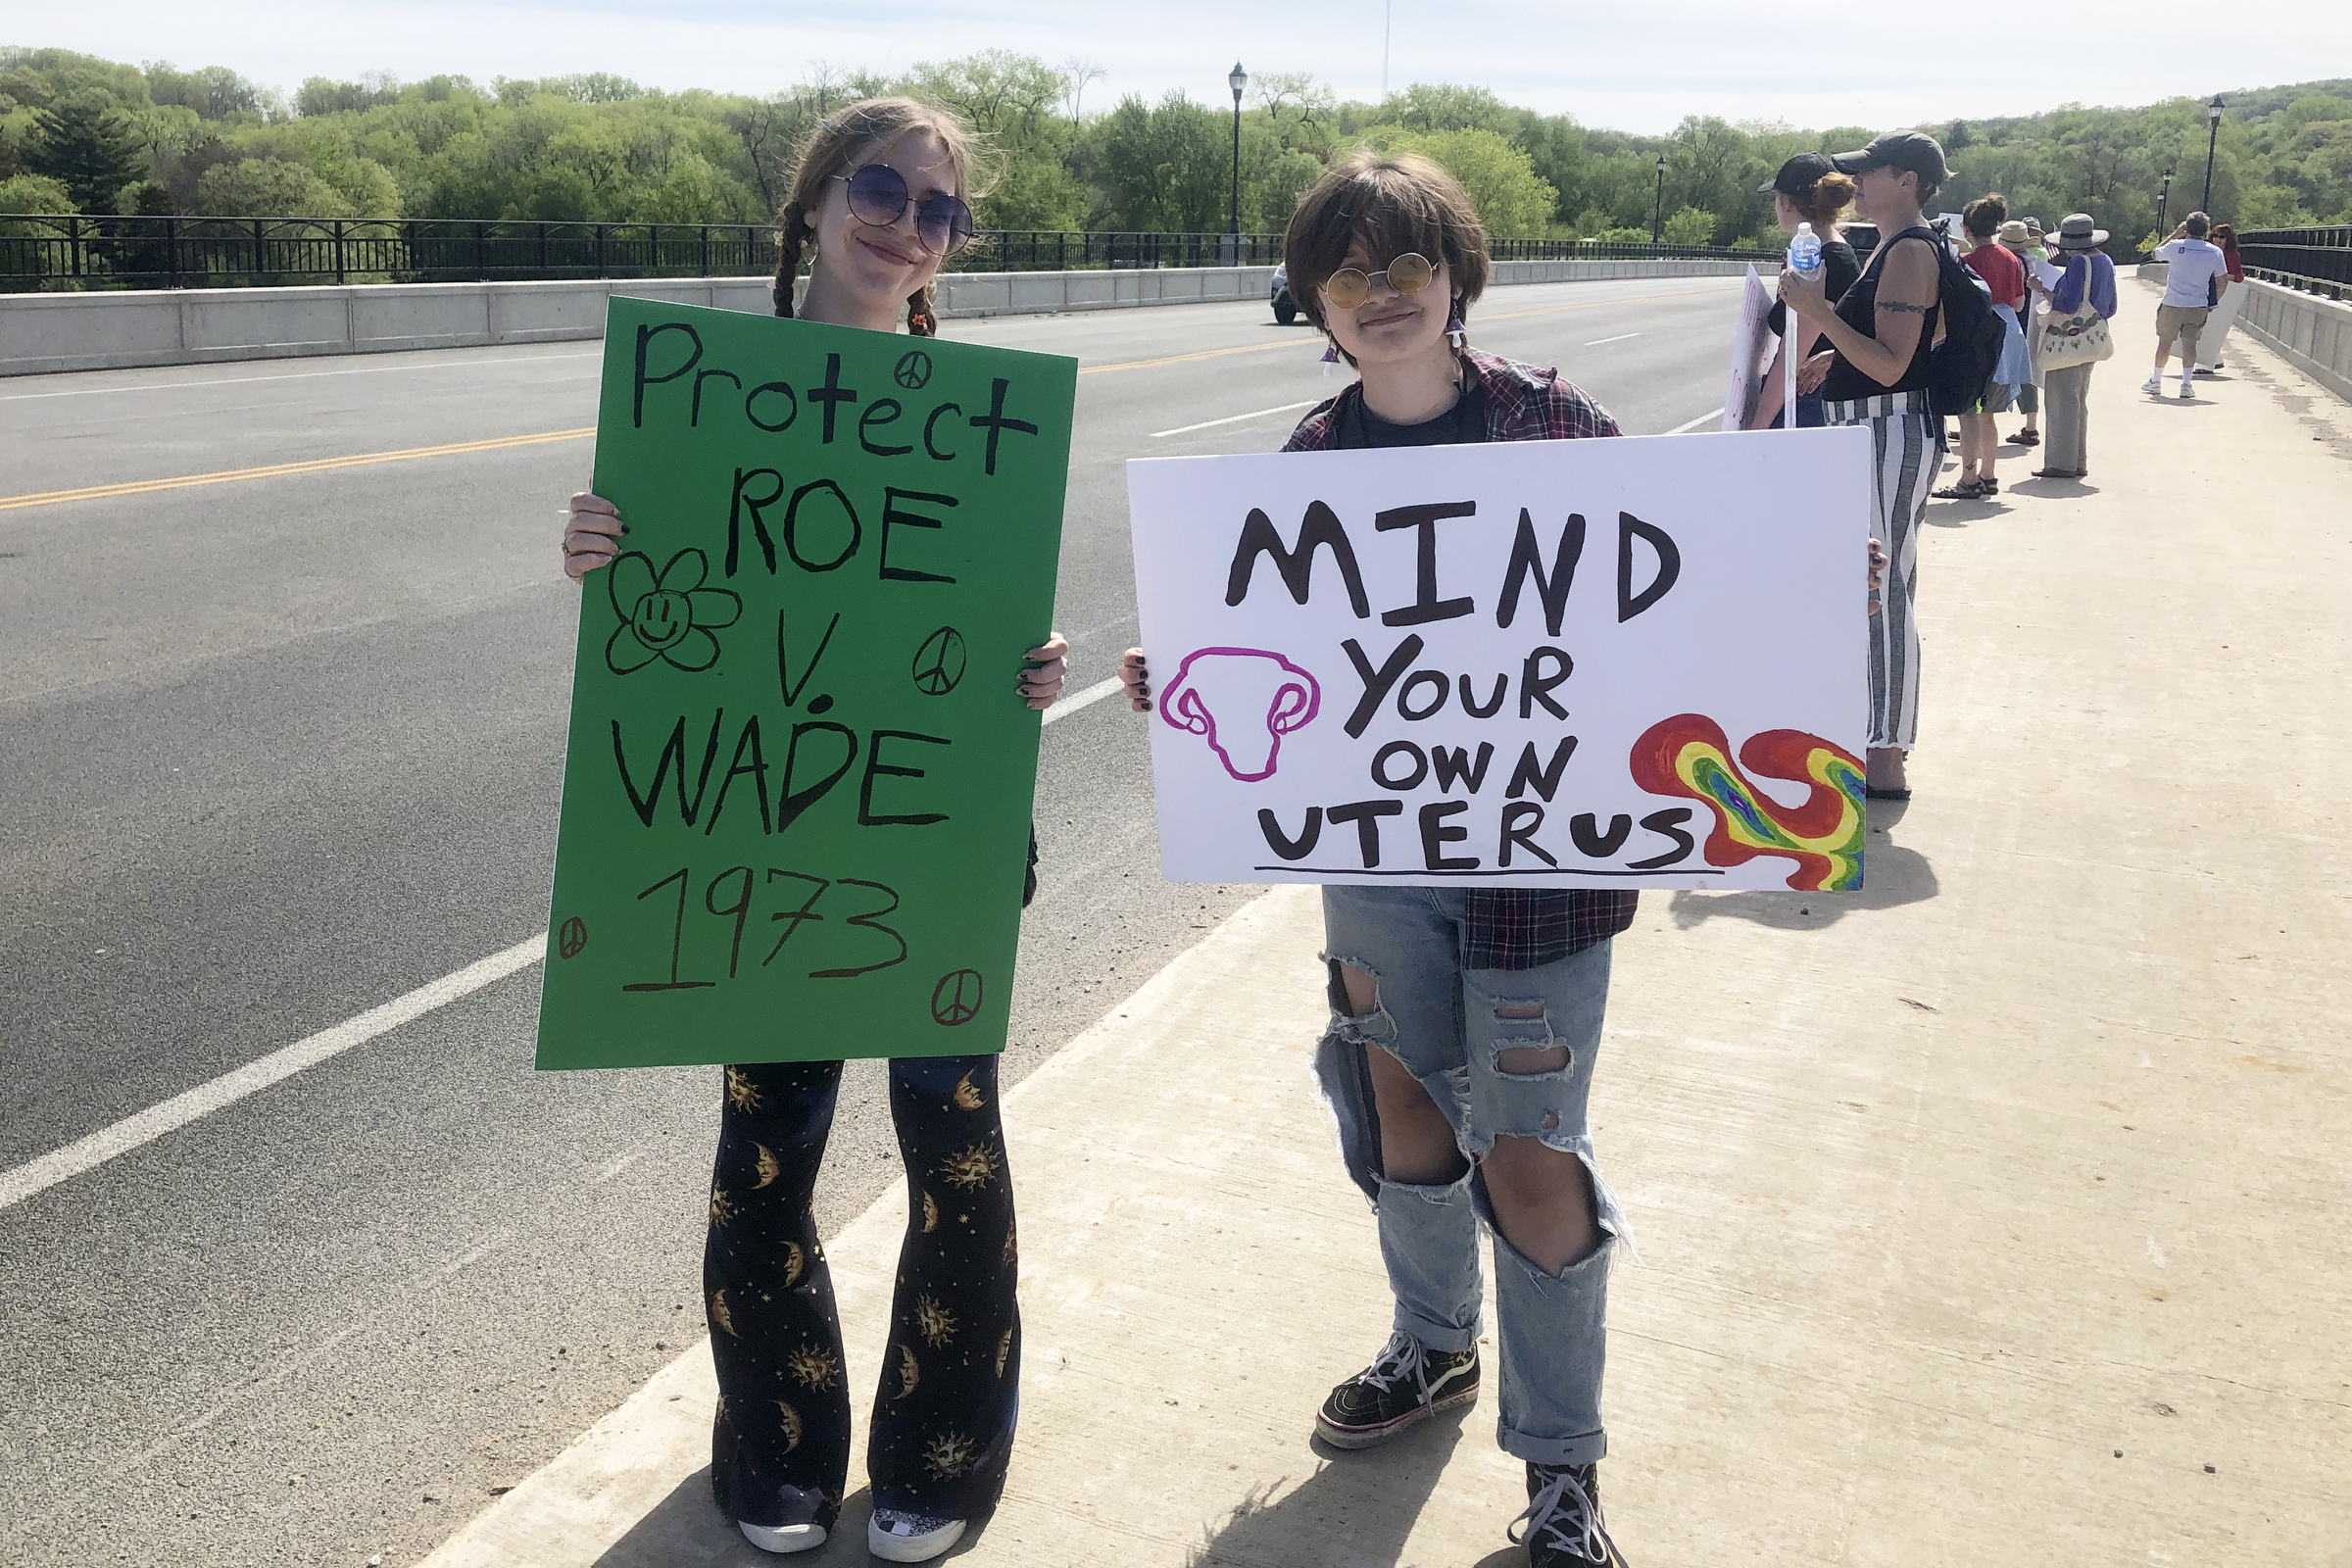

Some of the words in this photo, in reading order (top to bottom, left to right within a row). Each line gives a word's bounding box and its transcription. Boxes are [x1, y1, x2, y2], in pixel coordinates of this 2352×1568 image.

[633, 322, 1039, 476] Protect
[724, 466, 960, 584] ROE
[1225, 500, 1681, 637] MIND
[777, 609, 841, 715] V.
[1341, 633, 1575, 740] YOUR
[611, 707, 953, 837] WADE
[1371, 736, 1579, 804] OWN
[1257, 798, 1694, 871] UTERUS
[621, 865, 908, 993] 1973
